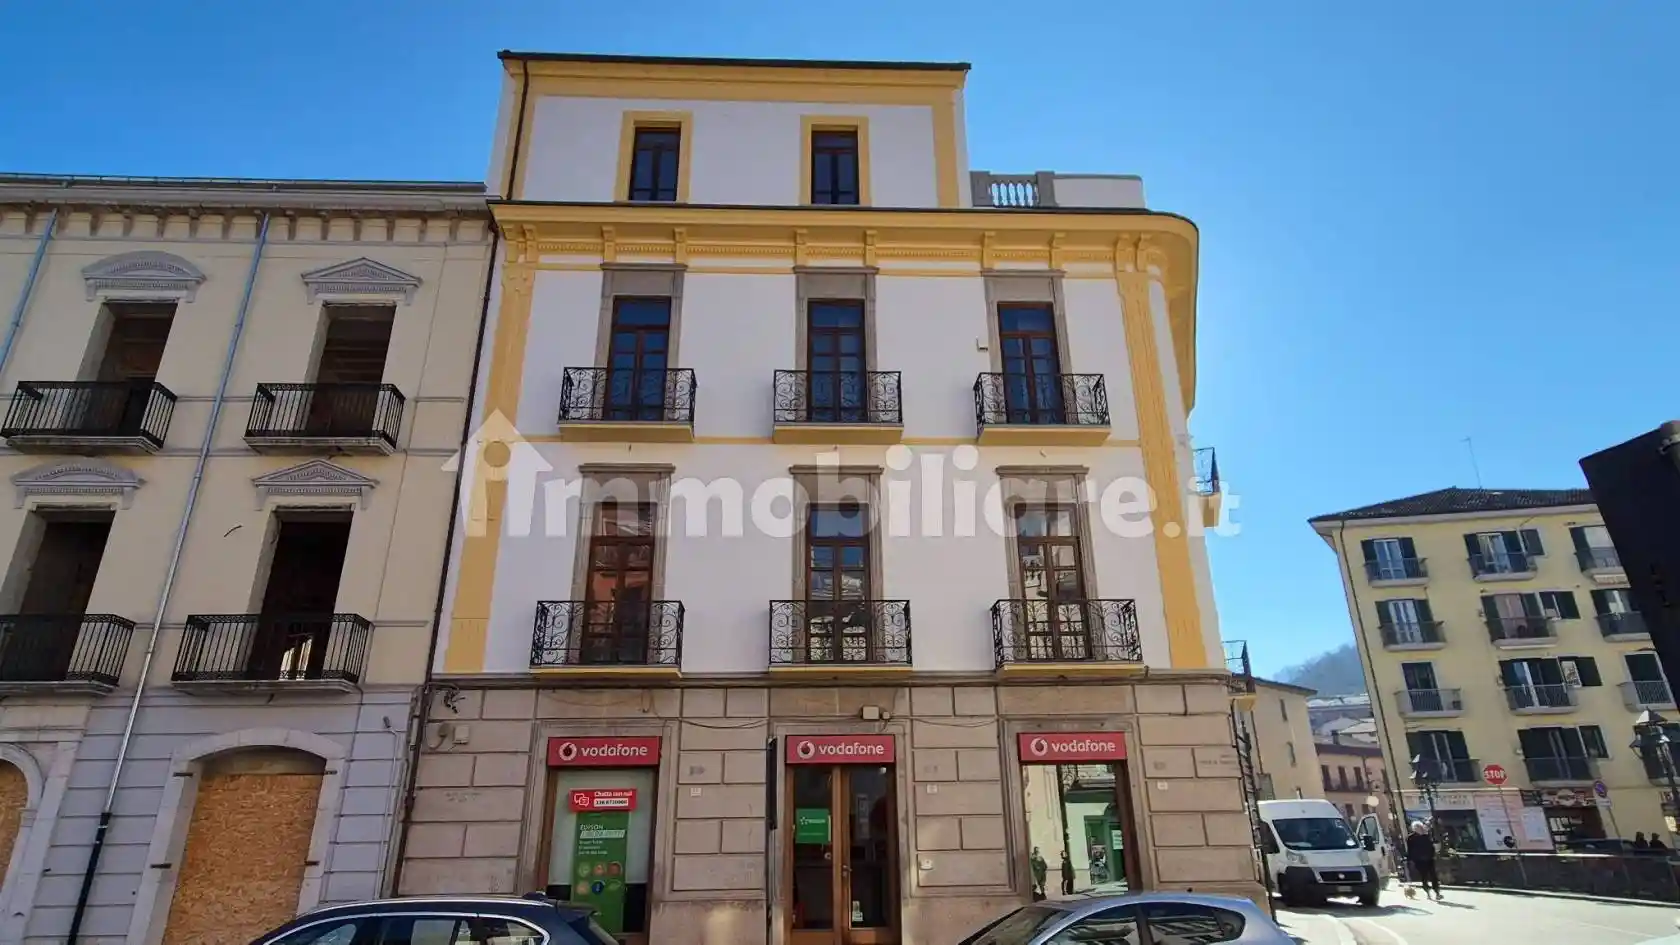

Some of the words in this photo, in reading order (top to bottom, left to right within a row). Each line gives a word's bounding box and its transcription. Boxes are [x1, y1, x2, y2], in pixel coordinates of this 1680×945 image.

[581, 743, 648, 757] vodafone
[818, 742, 885, 755] vodafone
[1051, 739, 1117, 753] vodafone
[1484, 769, 1505, 779] STOP
